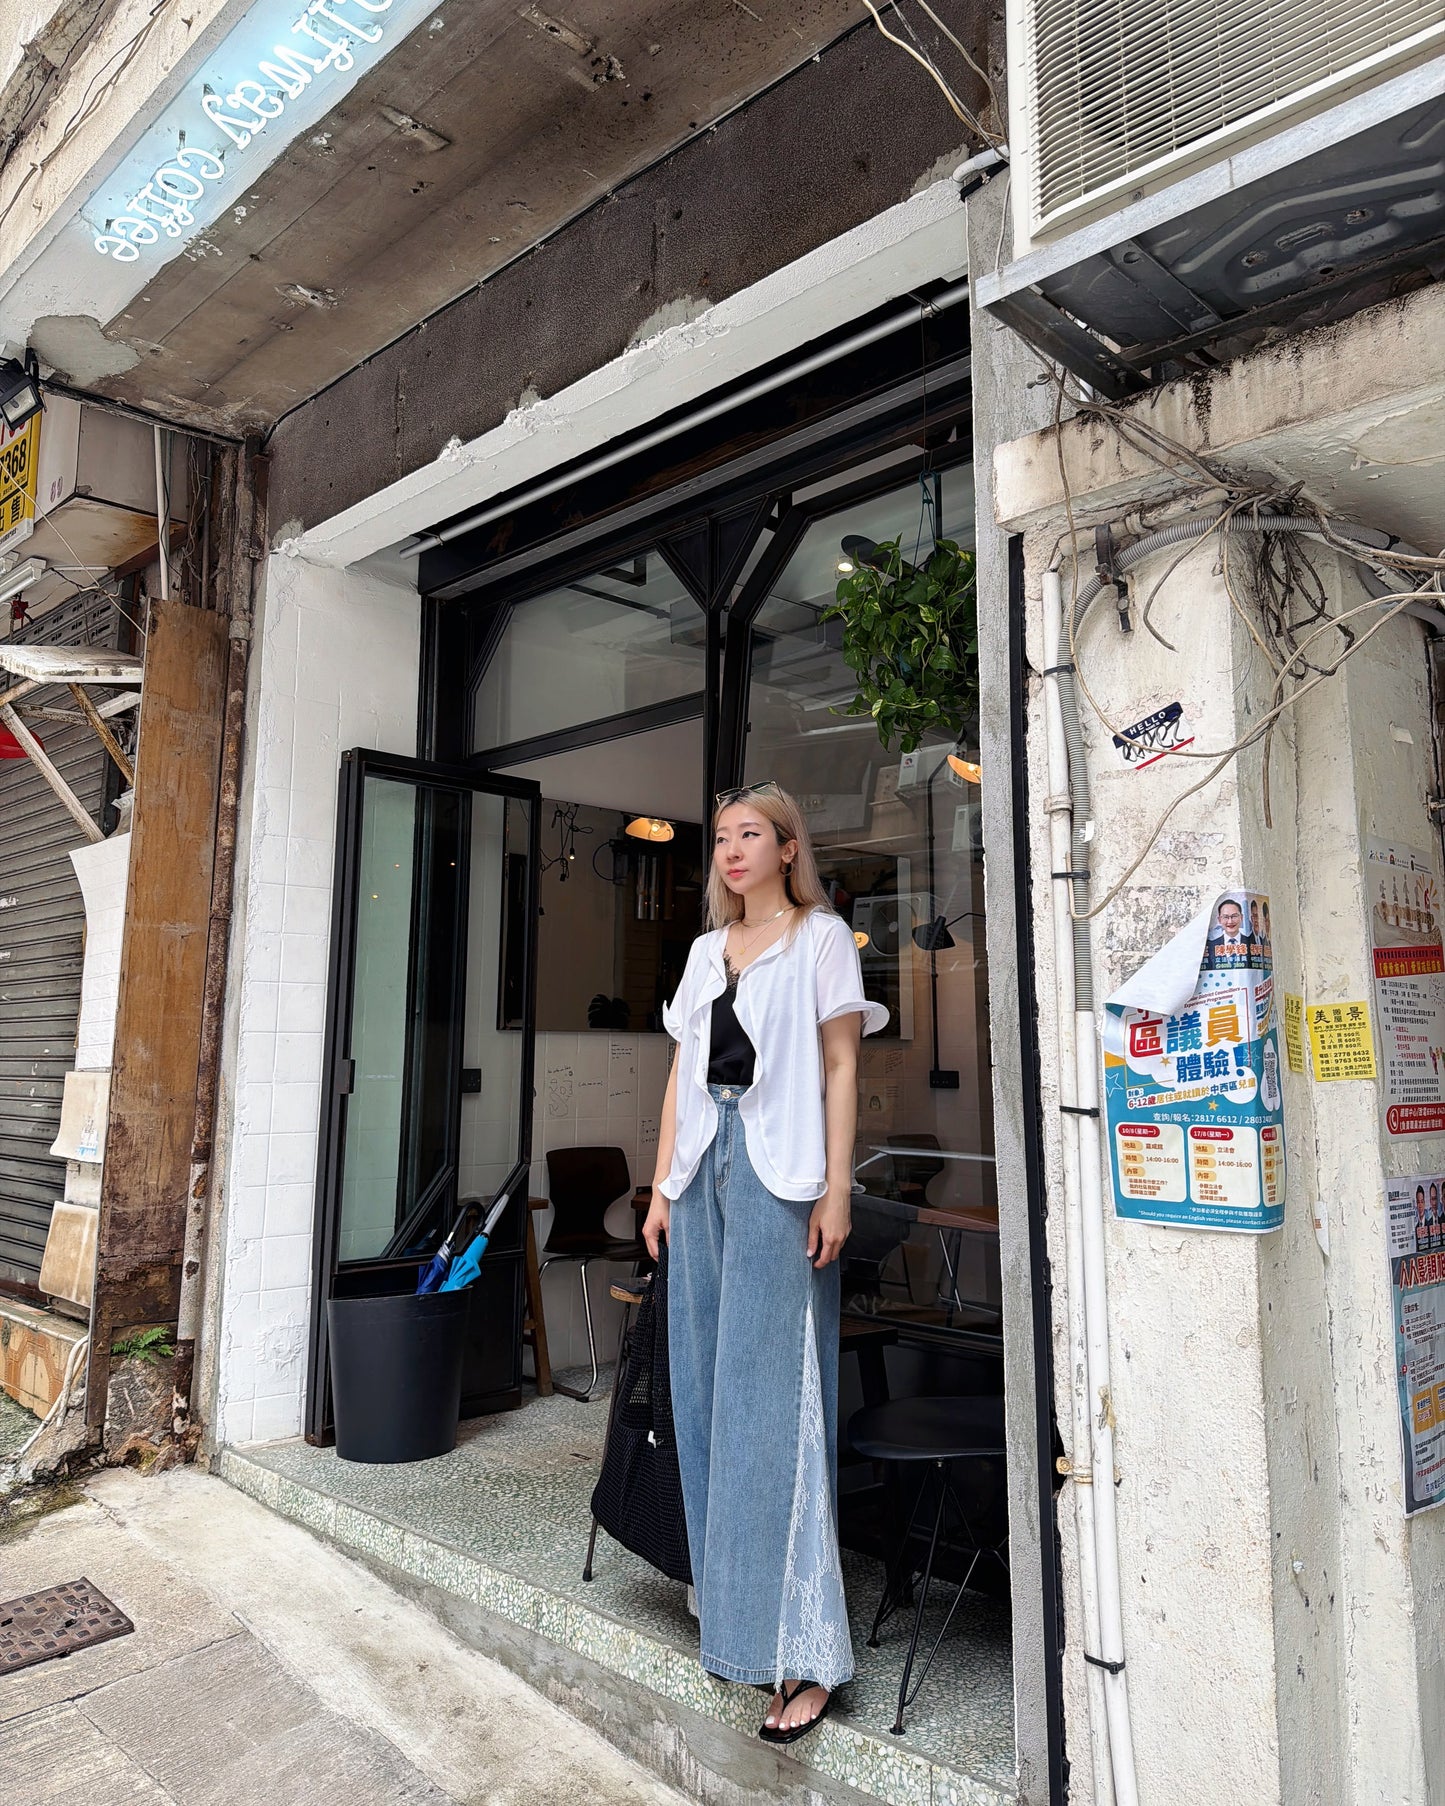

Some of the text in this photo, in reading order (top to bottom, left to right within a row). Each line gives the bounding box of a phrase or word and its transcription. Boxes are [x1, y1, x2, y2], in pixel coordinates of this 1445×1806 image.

[94, 0, 392, 262] lfway coffee
[1129, 711, 1166, 735] HELLO
[1313, 1009, 1330, 1024] 美
[1346, 1006, 1363, 1021] 景
[1129, 1004, 1243, 1058] 區議員
[1216, 1115, 1237, 1123] 6612
